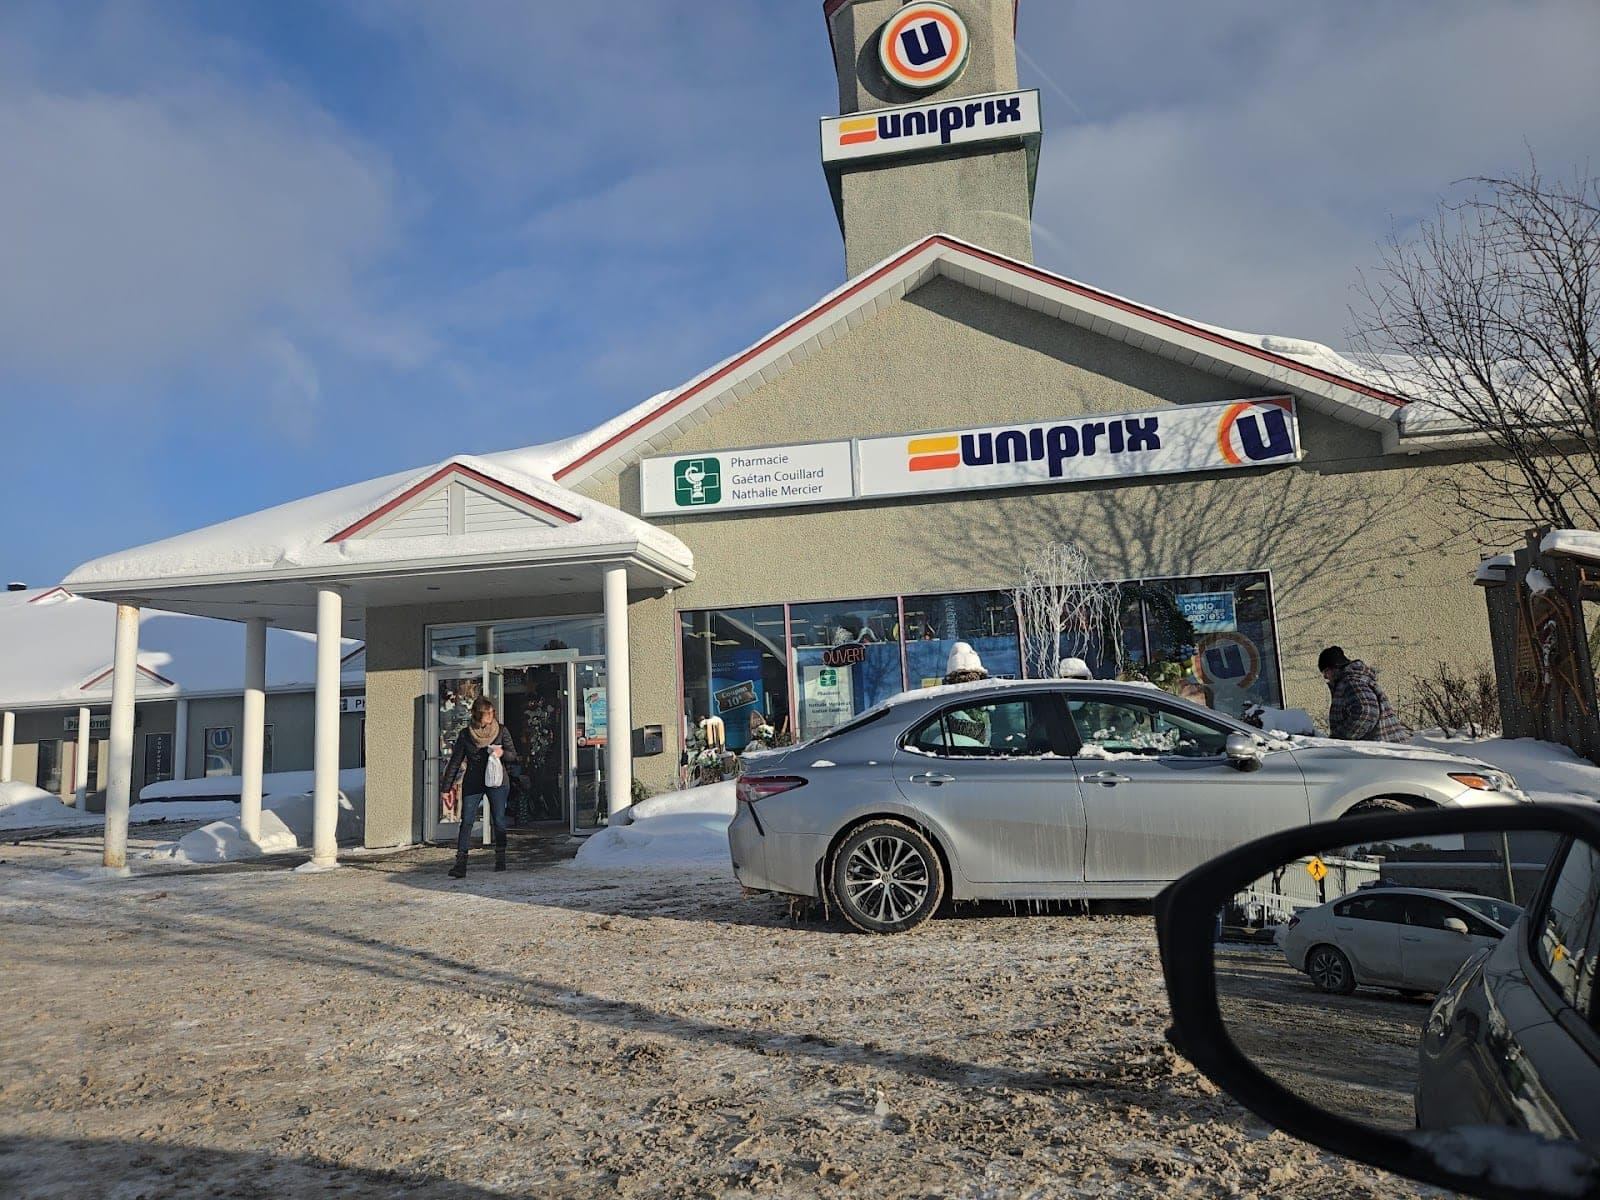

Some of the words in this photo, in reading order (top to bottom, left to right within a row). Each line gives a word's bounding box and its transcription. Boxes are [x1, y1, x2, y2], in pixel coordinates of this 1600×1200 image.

[878, 96, 1021, 144] uniprix
[960, 416, 1161, 477] uniprix
[731, 454, 789, 468] Pharmacie
[731, 473, 771, 485] Gaétan
[774, 467, 824, 482] Couillard
[732, 487, 778, 500] Nathalie
[781, 483, 823, 496] Mercier
[823, 647, 865, 665] OUVERT
